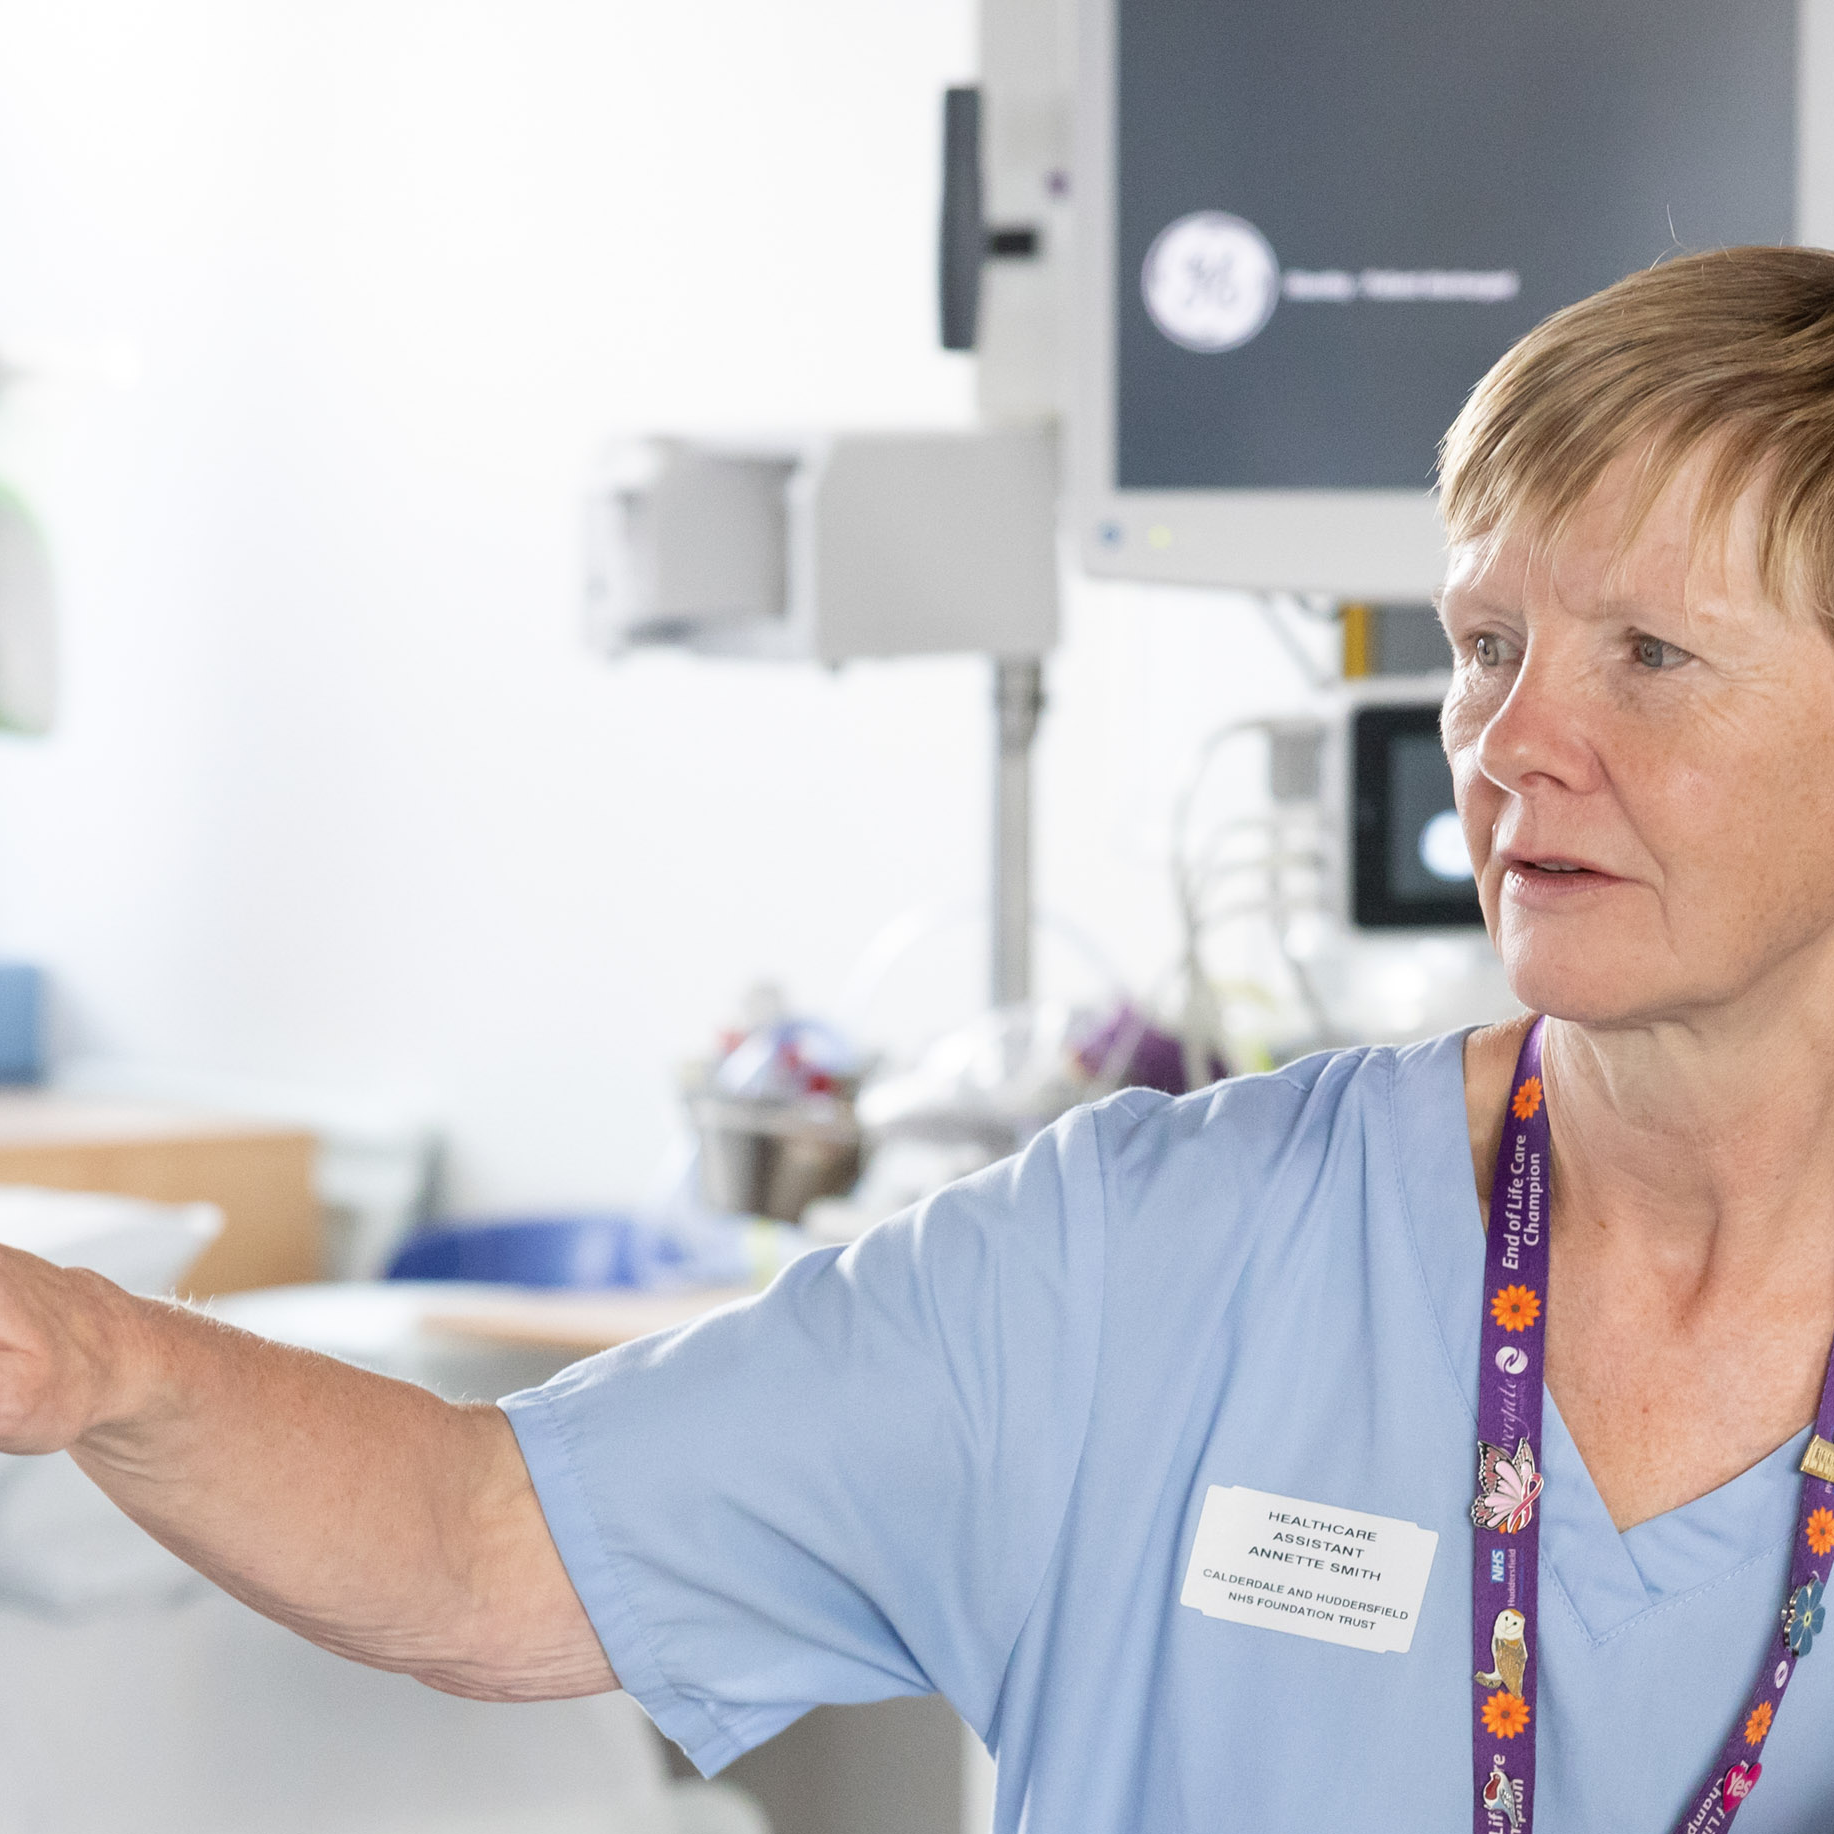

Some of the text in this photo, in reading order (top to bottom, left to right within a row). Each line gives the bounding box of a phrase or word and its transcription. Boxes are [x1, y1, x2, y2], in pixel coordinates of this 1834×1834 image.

[1502, 1134, 1527, 1270] End of Life Care
[1523, 1152, 1544, 1247] Champion
[1268, 1511, 1378, 1542] HEALTHCARE
[1273, 1531, 1365, 1559] ASSISTANT
[1248, 1545, 1382, 1582] ANNETTE SMITH
[1492, 1549, 1505, 1582] NHS
[1508, 1549, 1517, 1607] Huddersfield
[1202, 1568, 1409, 1621] CALDERDALE AND HUDDERSFIELD
[1228, 1591, 1376, 1631] NHS FOUNDATION TRUST
[1726, 1771, 1752, 1798] Yes
